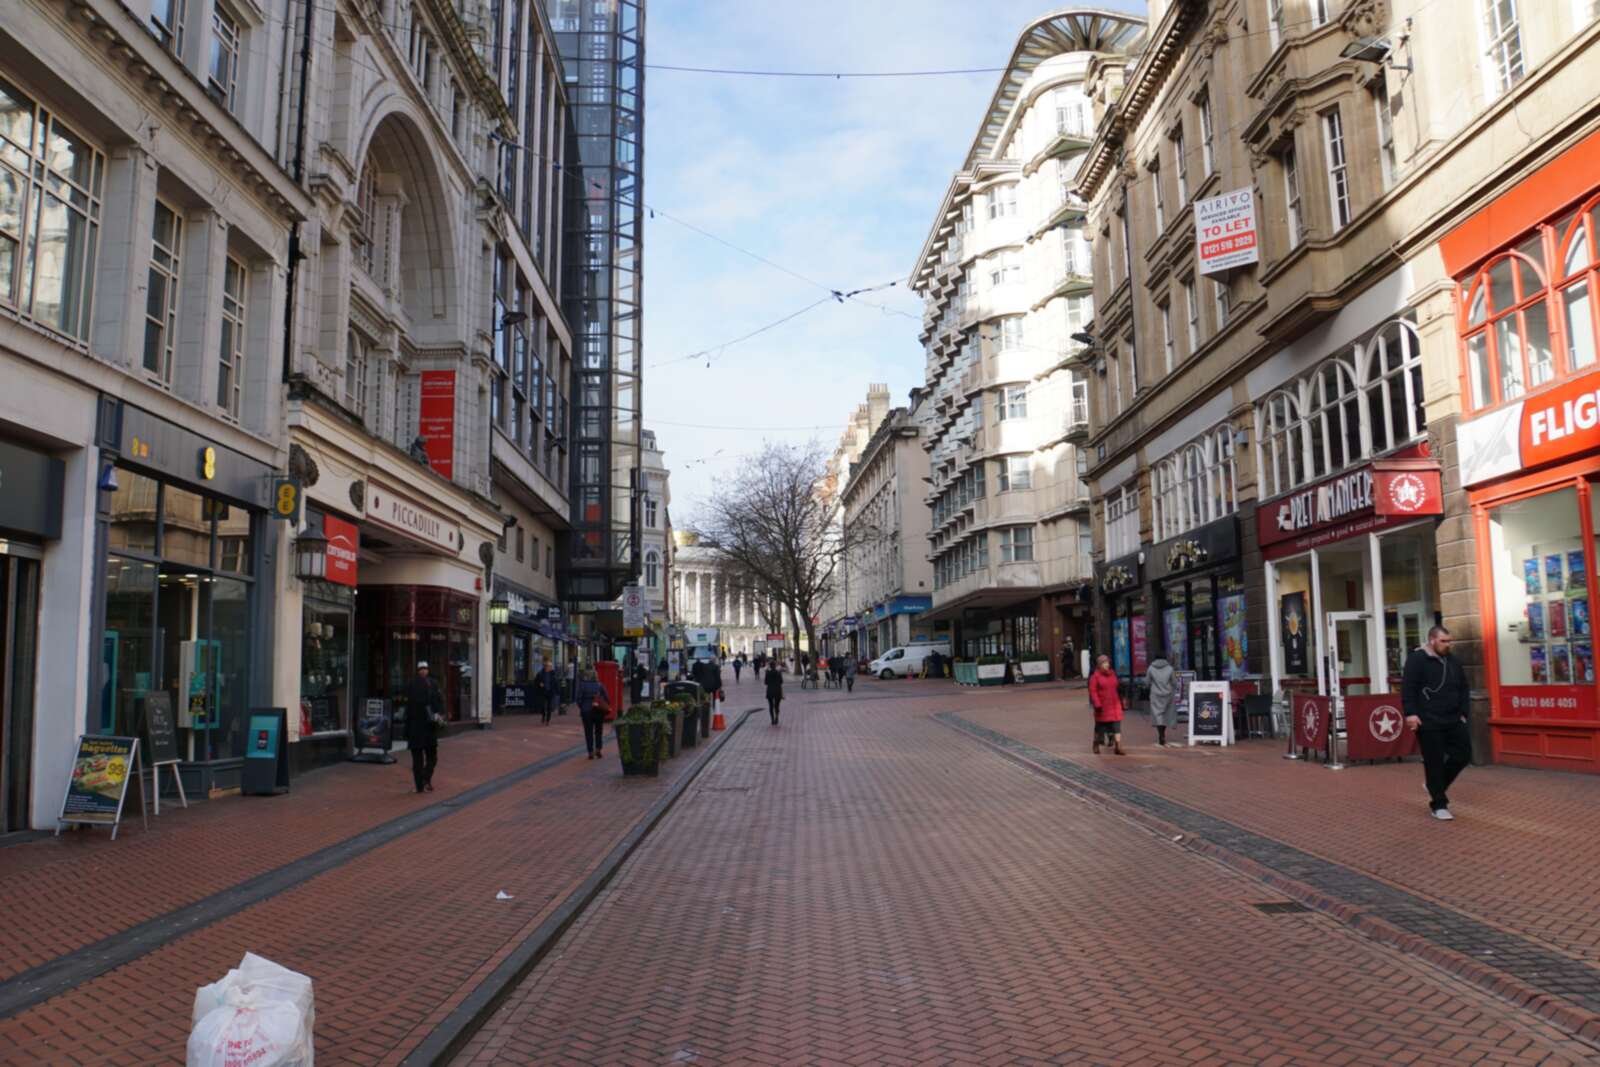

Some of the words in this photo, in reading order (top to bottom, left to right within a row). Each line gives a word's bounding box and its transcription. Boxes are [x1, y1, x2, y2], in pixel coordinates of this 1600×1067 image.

[1200, 192, 1250, 214] AIRIVO
[1202, 225, 1221, 238] TO
[1225, 217, 1249, 232] LET
[1530, 389, 1600, 446] FLIG
[1290, 491, 1313, 529] PRET
[1328, 471, 1373, 519] MANGER
[392, 502, 440, 538] PICCADILLY
